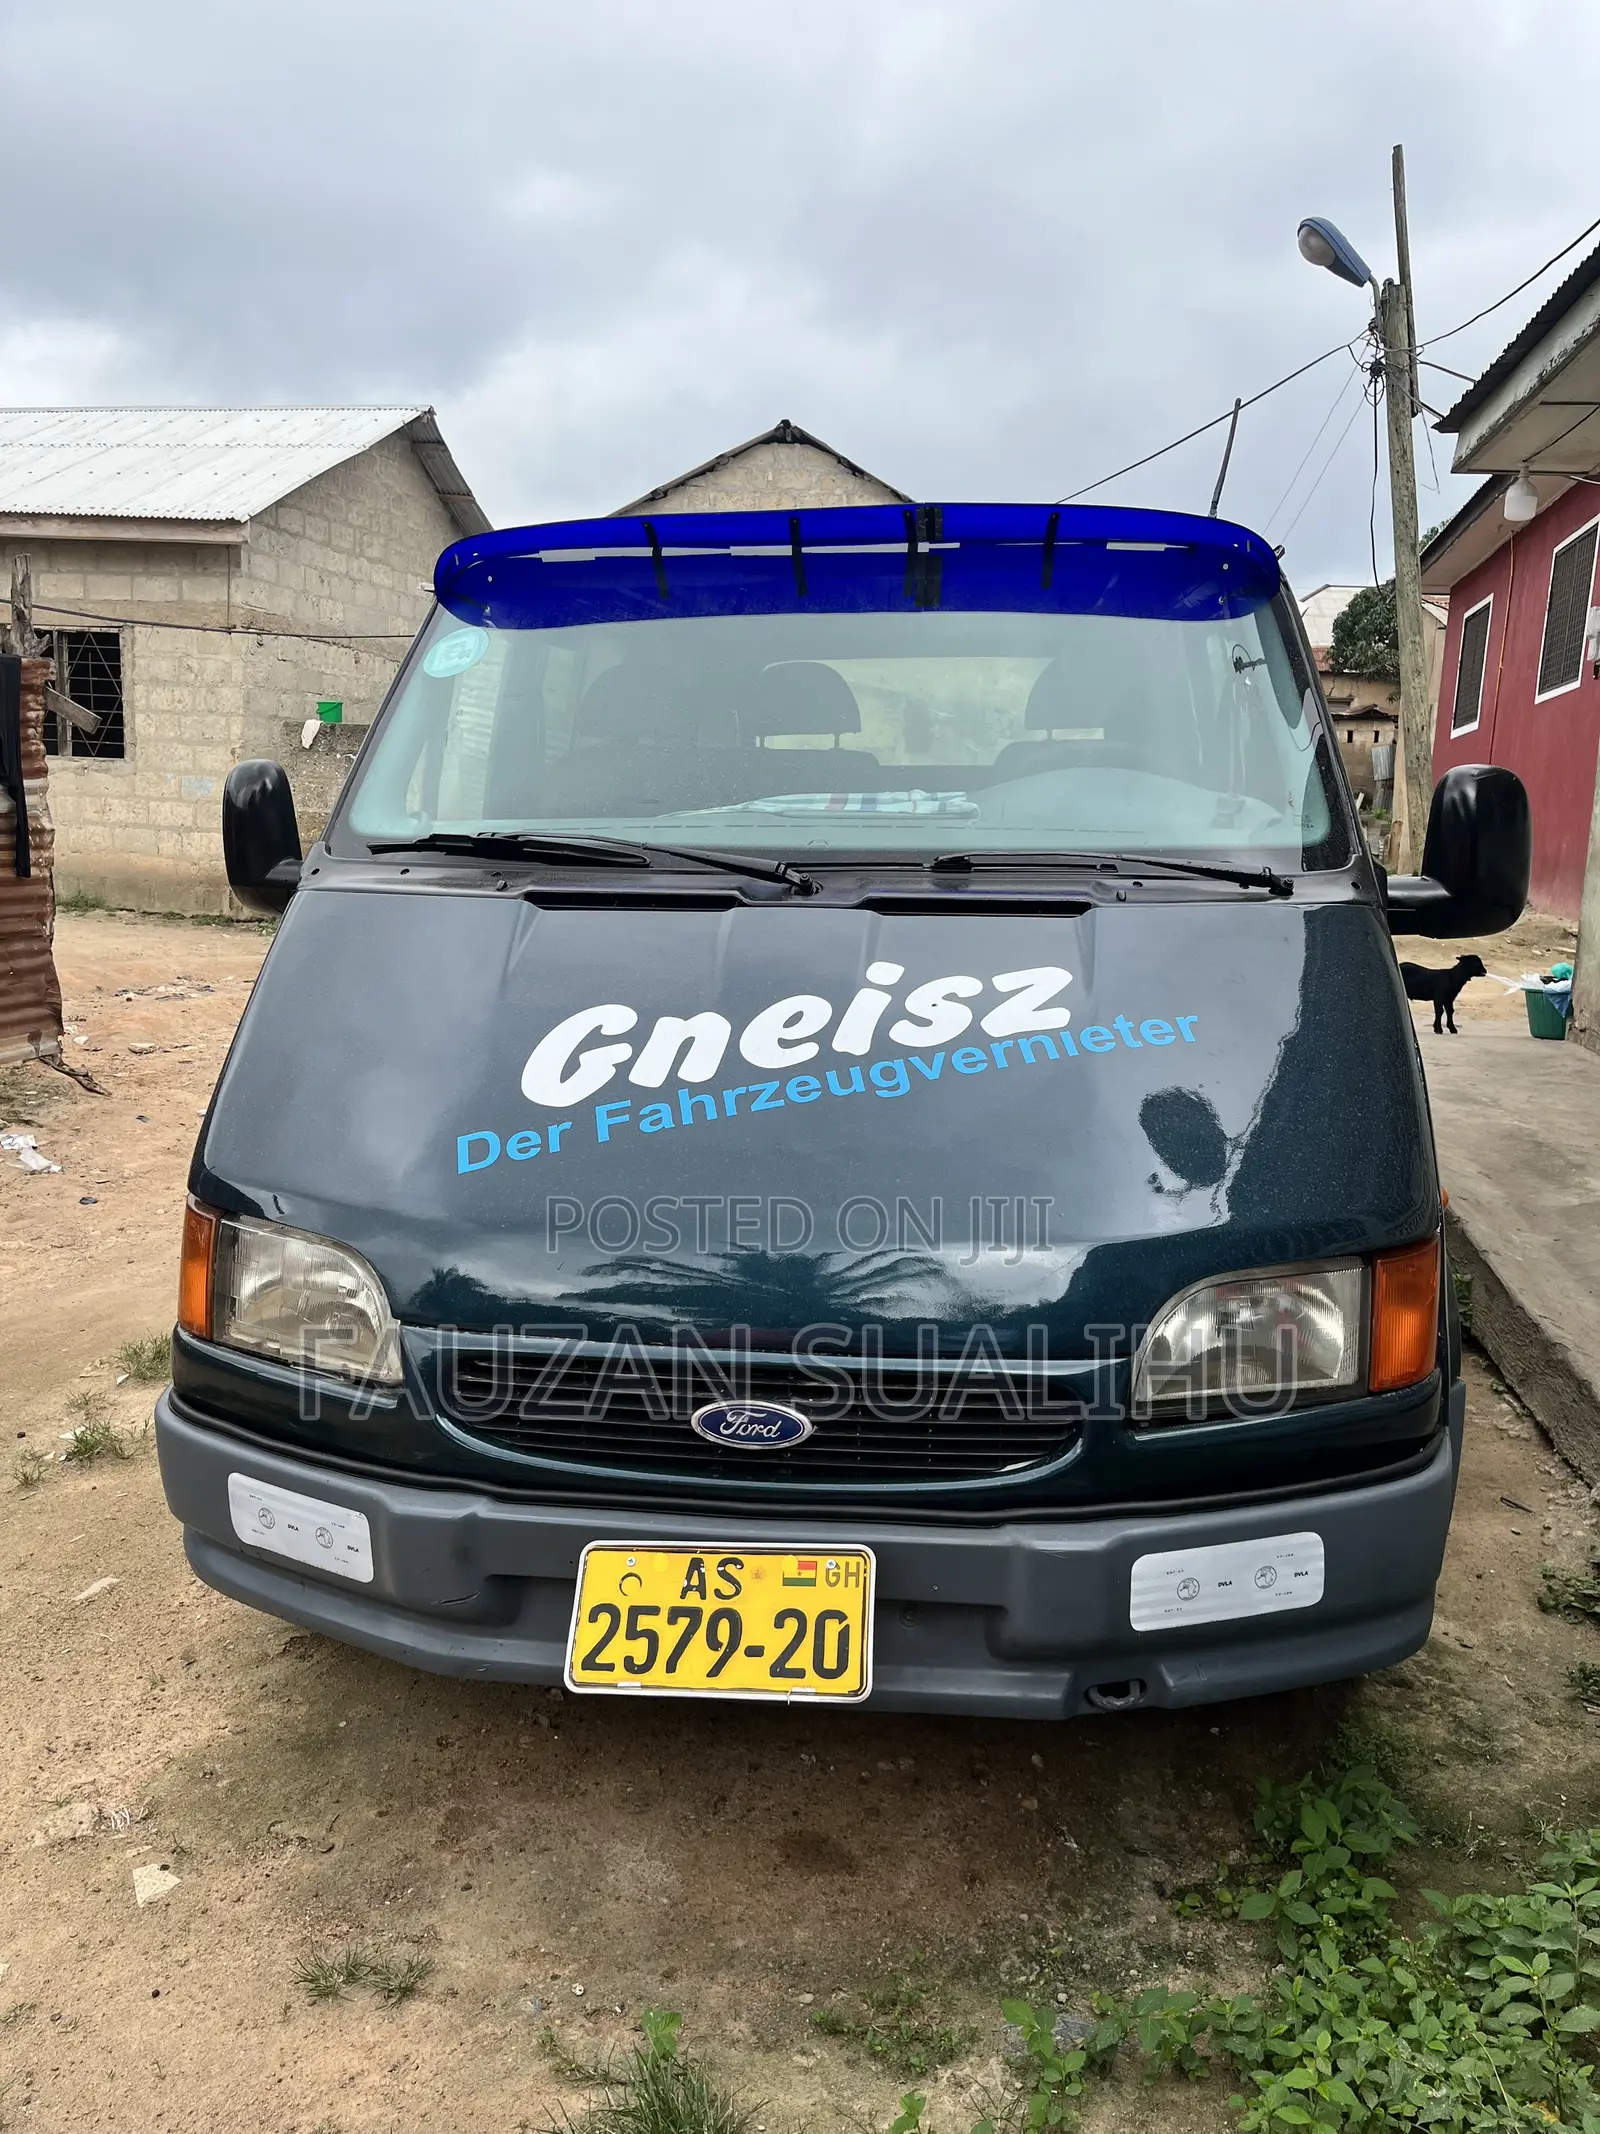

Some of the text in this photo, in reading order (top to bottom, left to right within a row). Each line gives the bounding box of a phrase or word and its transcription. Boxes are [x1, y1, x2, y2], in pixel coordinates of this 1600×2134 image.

[520, 961, 1073, 1107] Gneisz
[456, 1116, 572, 1174] Der
[719, 1409, 782, 1438] Ford
[680, 1557, 860, 1600] AS GH
[1217, 1580, 1233, 1588] DVLA
[1293, 1570, 1309, 1578] DVLA
[581, 1603, 851, 1680] 2579-20
